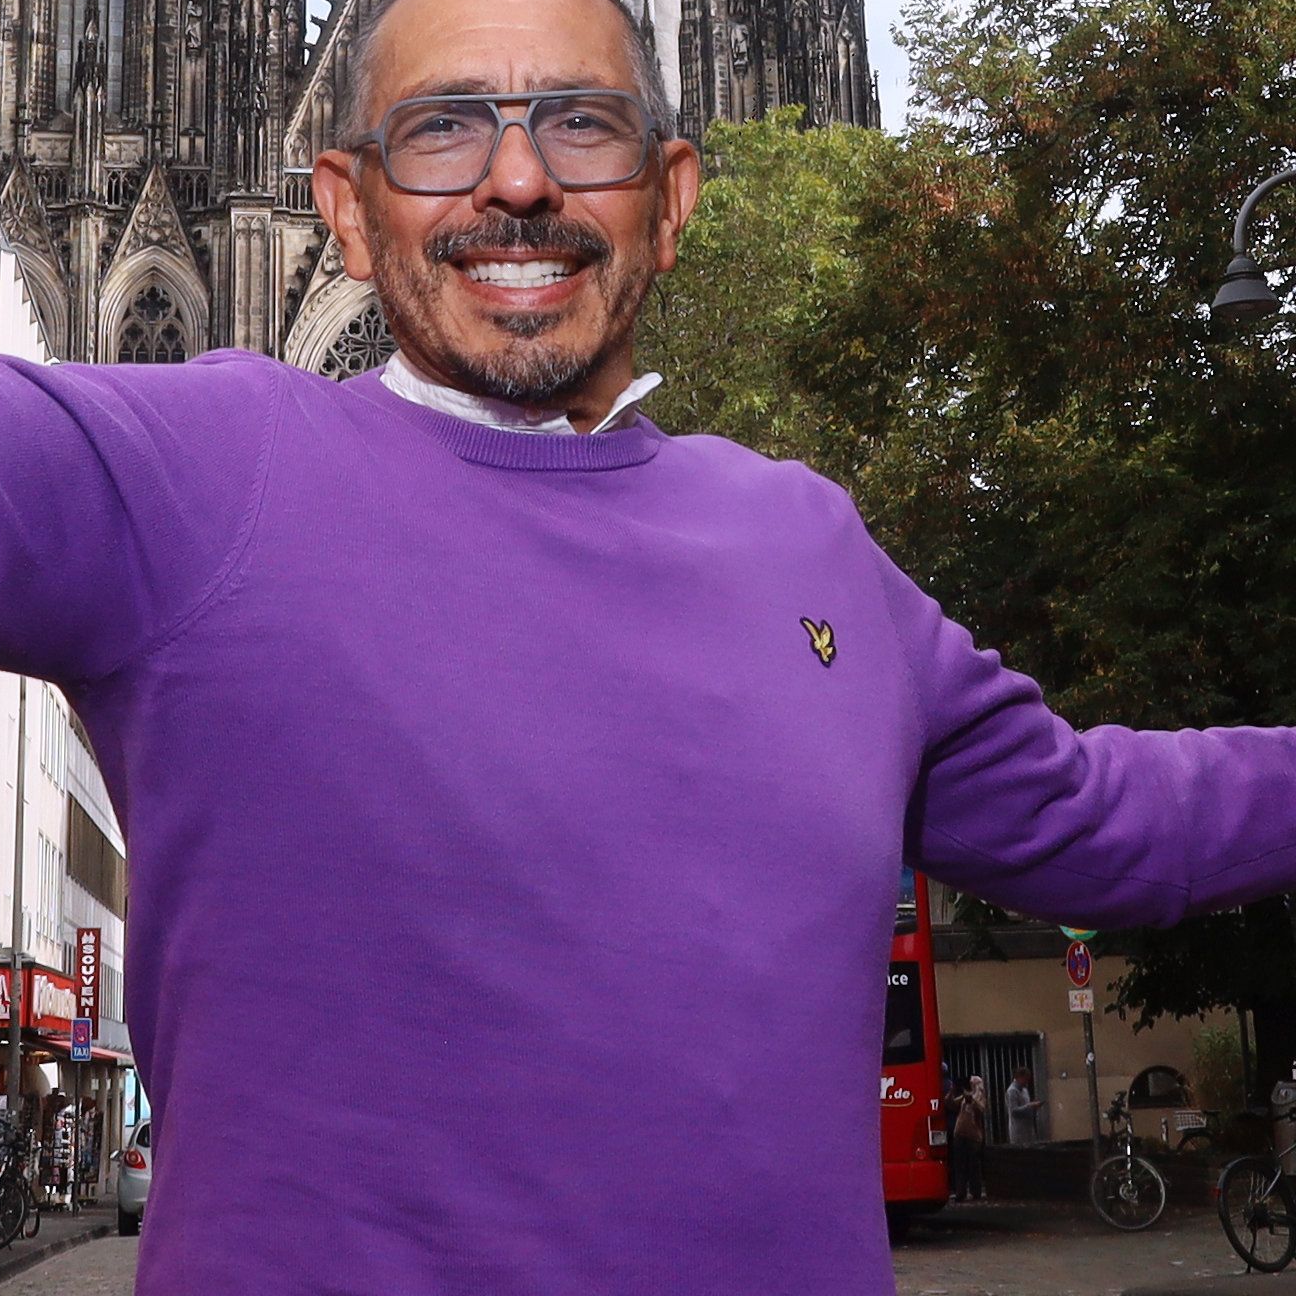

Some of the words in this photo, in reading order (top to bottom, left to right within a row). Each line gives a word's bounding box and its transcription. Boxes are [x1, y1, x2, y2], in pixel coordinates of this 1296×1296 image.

[81, 944, 95, 1017] SOUVENI
[74, 1047, 89, 1057] TAXI
[880, 1076, 911, 1100] r.de
